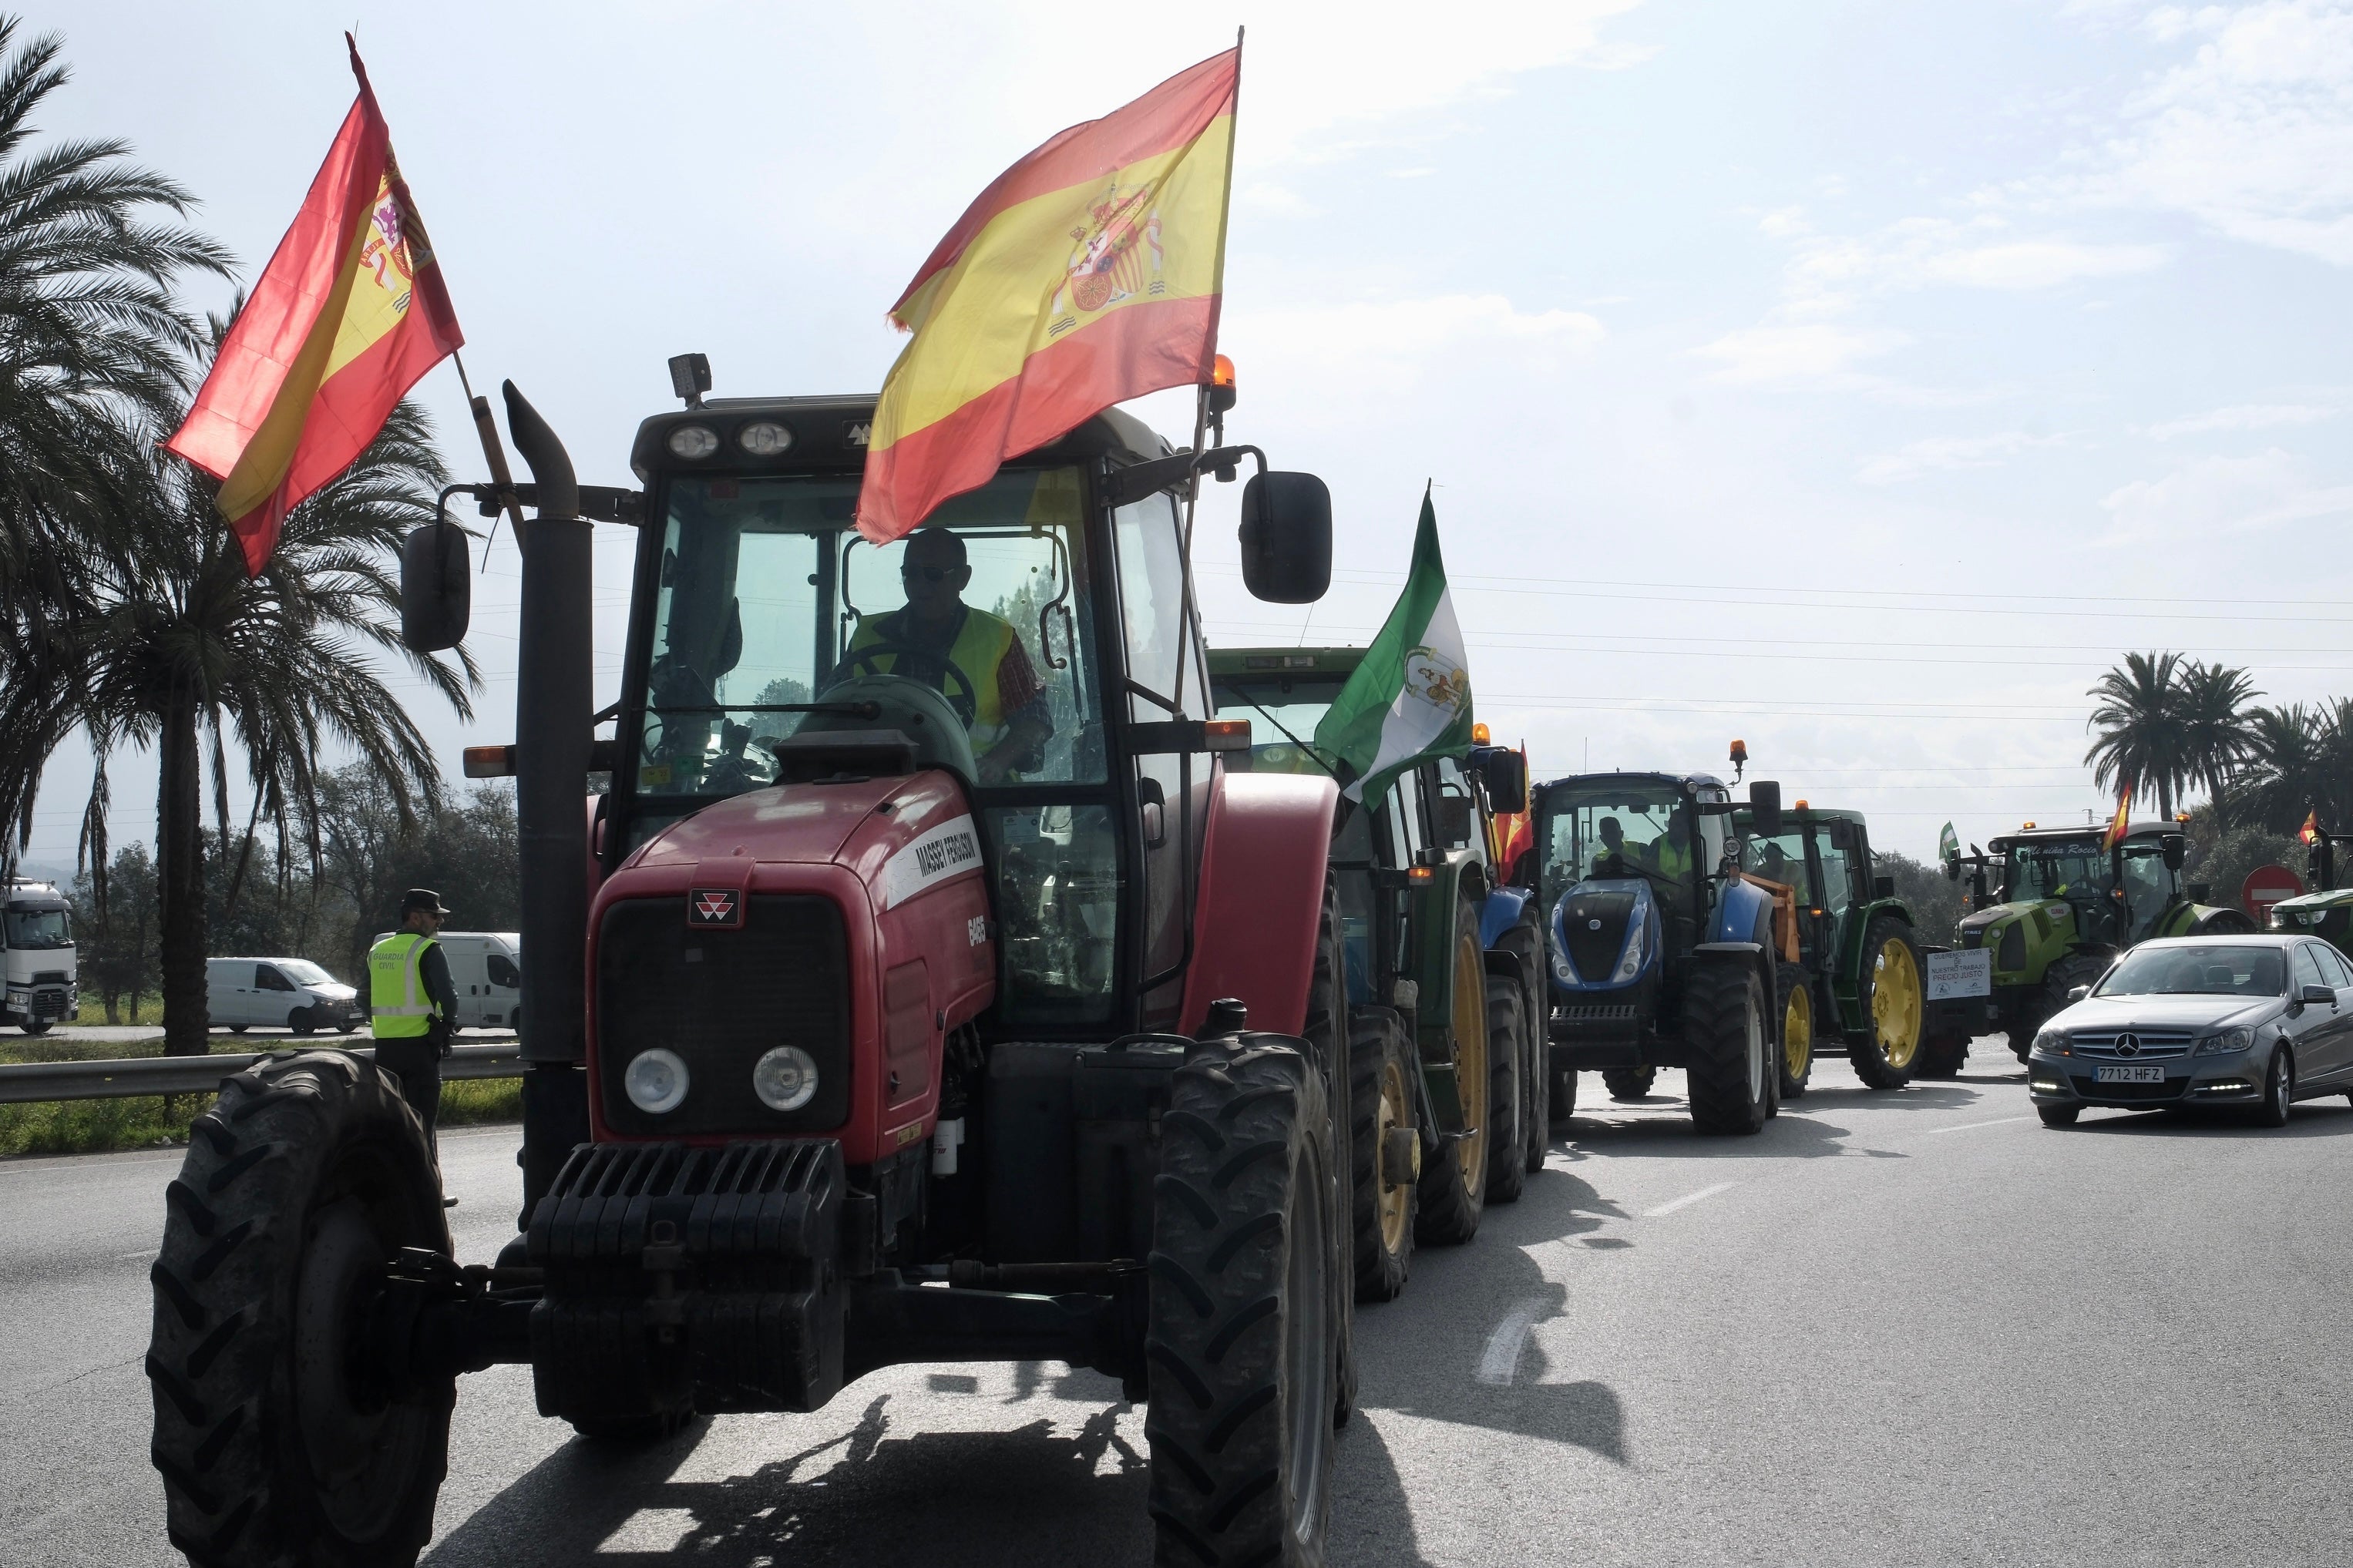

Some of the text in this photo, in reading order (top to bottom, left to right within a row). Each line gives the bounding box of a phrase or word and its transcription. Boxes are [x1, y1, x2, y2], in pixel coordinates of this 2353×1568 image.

[916, 832, 976, 878] MASSEY FERGUSON
[967, 915, 986, 947] 6465
[373, 952, 405, 961] GUARDIA
[1934, 951, 1966, 960] QUEREMOS
[1931, 965, 1958, 974] NUESTRO
[1932, 970, 1983, 981] PRECIO JUSTO
[2099, 1068, 2130, 1080] 7712
[2135, 1068, 2160, 1080] HFZ
